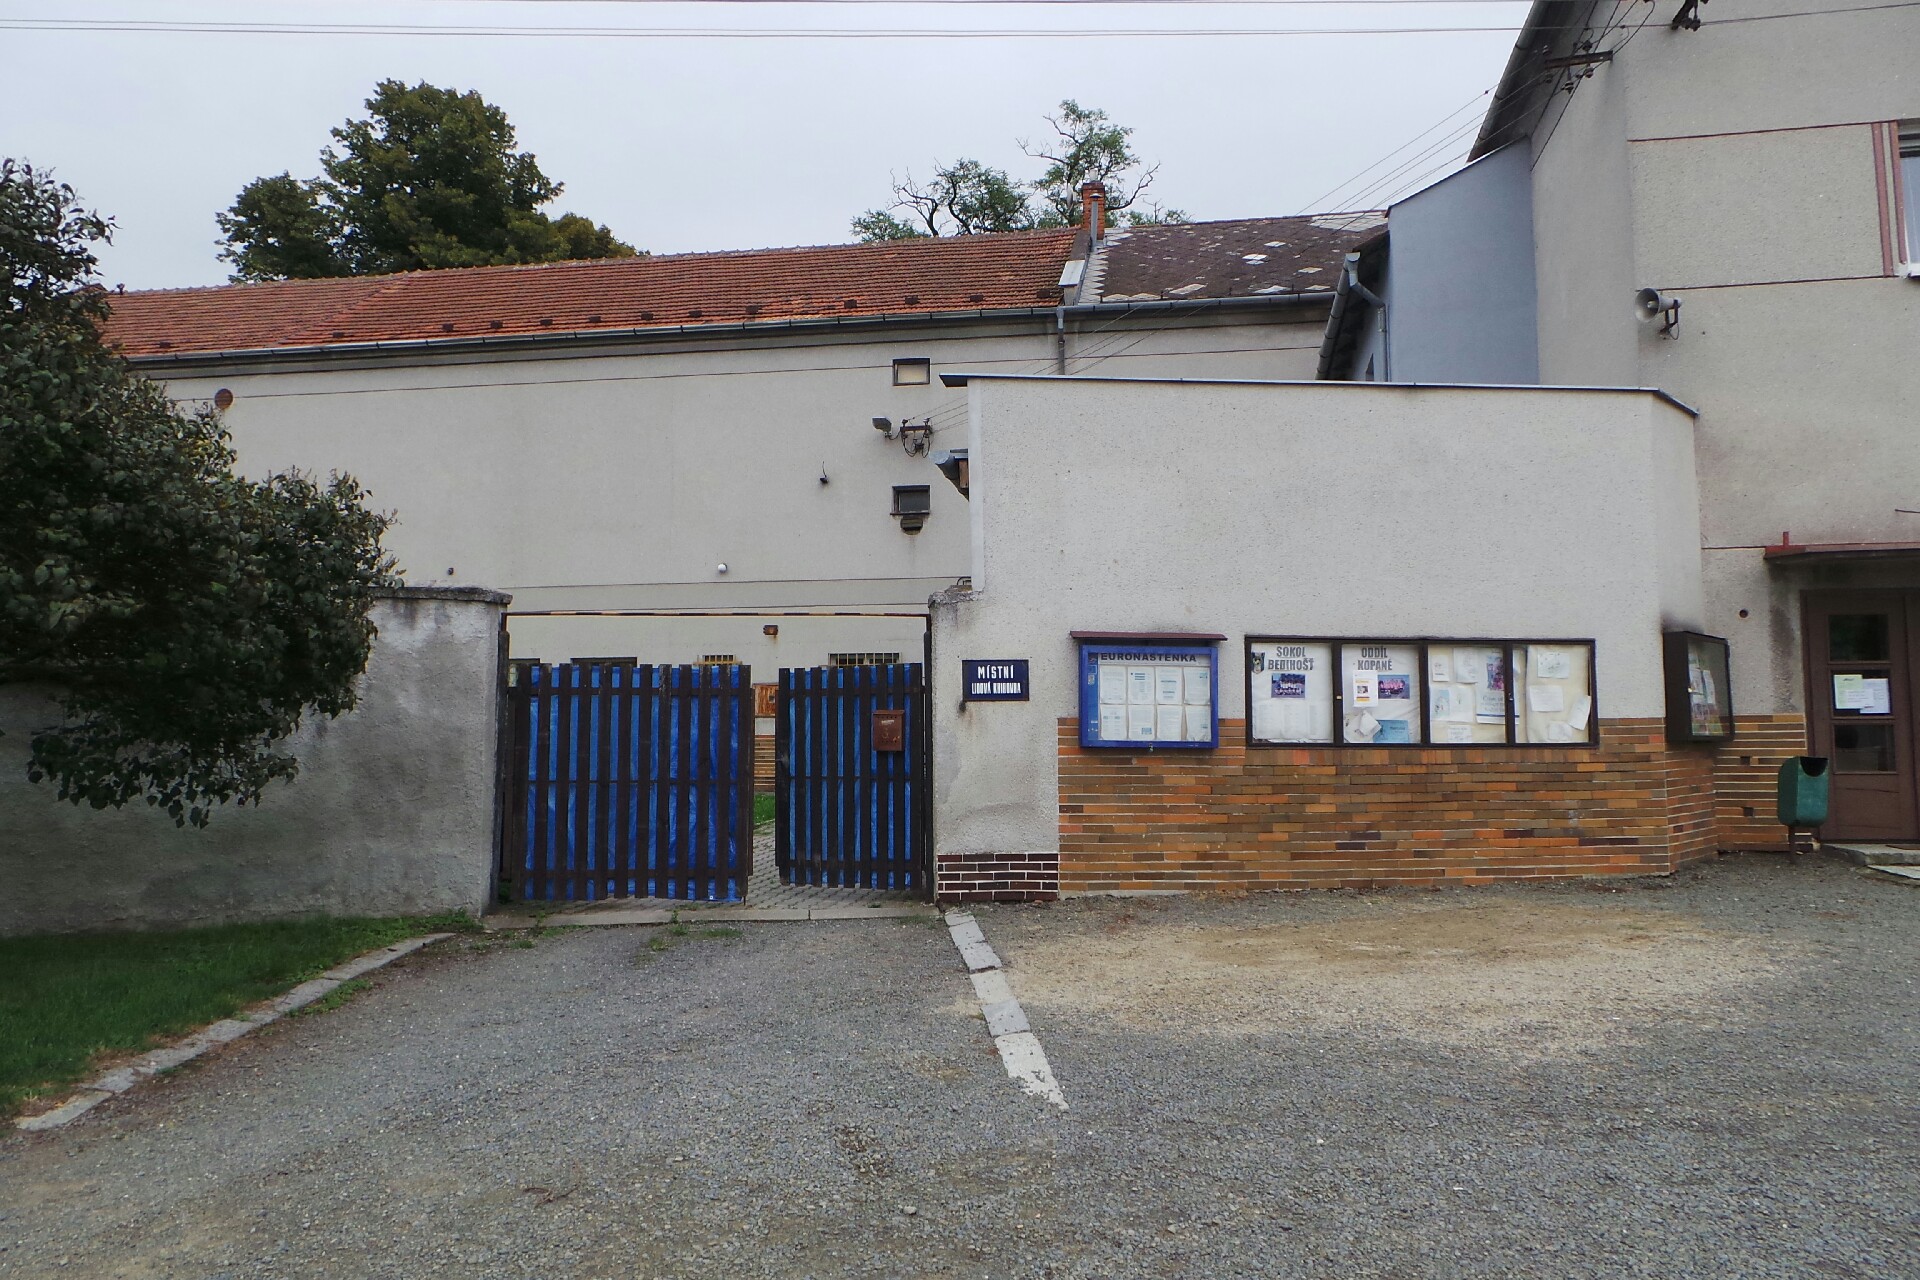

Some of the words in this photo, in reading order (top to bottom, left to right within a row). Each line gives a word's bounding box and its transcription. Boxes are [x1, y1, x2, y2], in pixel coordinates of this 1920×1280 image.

[1276, 646, 1306, 658] SOKOL
[1361, 645, 1388, 658] ODDÍL
[1357, 658, 1393, 671] KOPANÉ
[977, 664, 1014, 679] MÍSTNÍ
